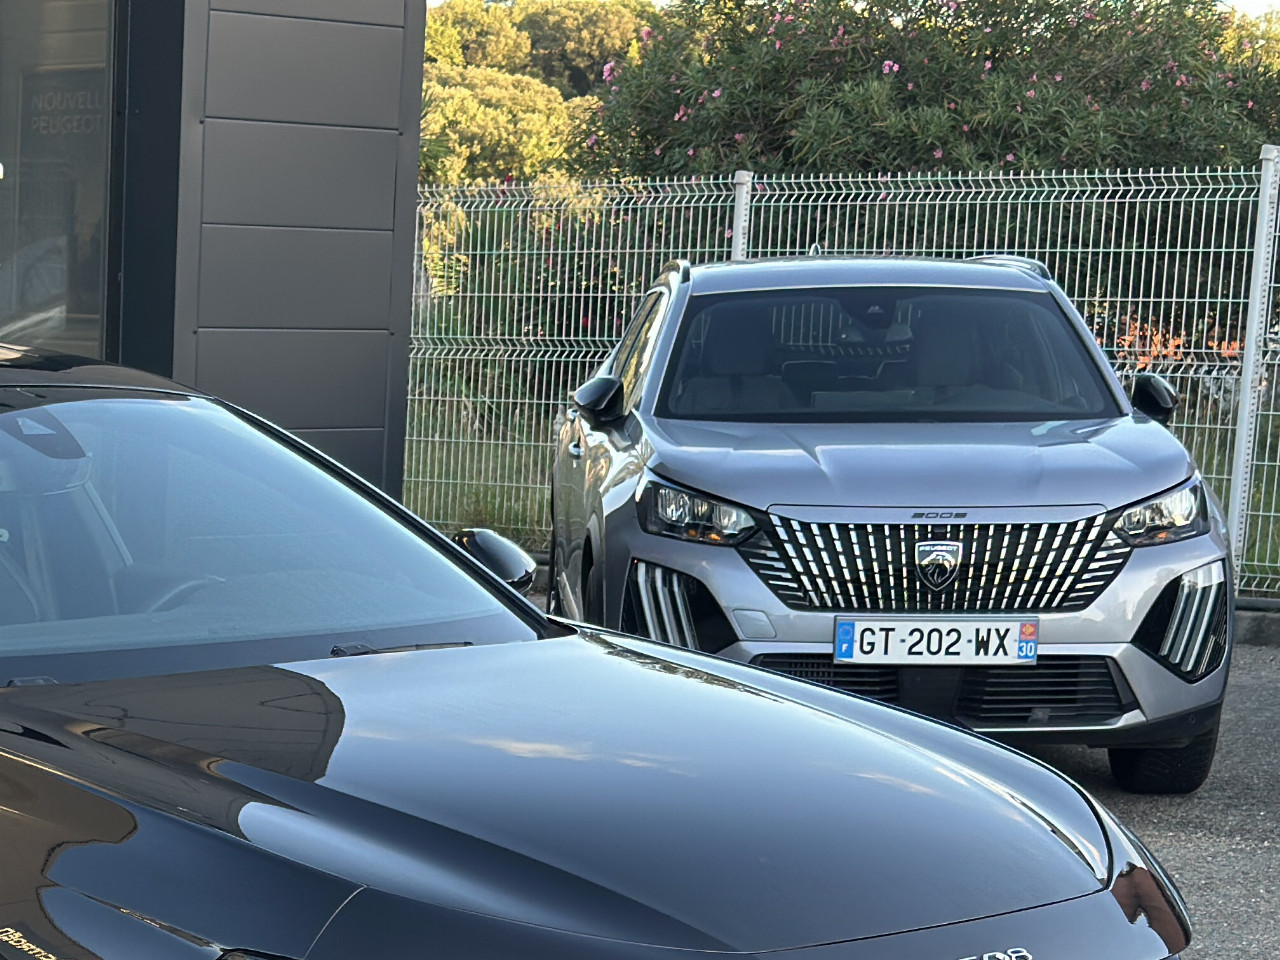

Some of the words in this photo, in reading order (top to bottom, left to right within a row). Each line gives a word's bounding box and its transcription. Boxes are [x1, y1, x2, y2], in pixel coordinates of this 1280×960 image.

[841, 643, 849, 653] F
[859, 627, 1011, 656] GT-202-WX
[1018, 642, 1035, 657] 30
